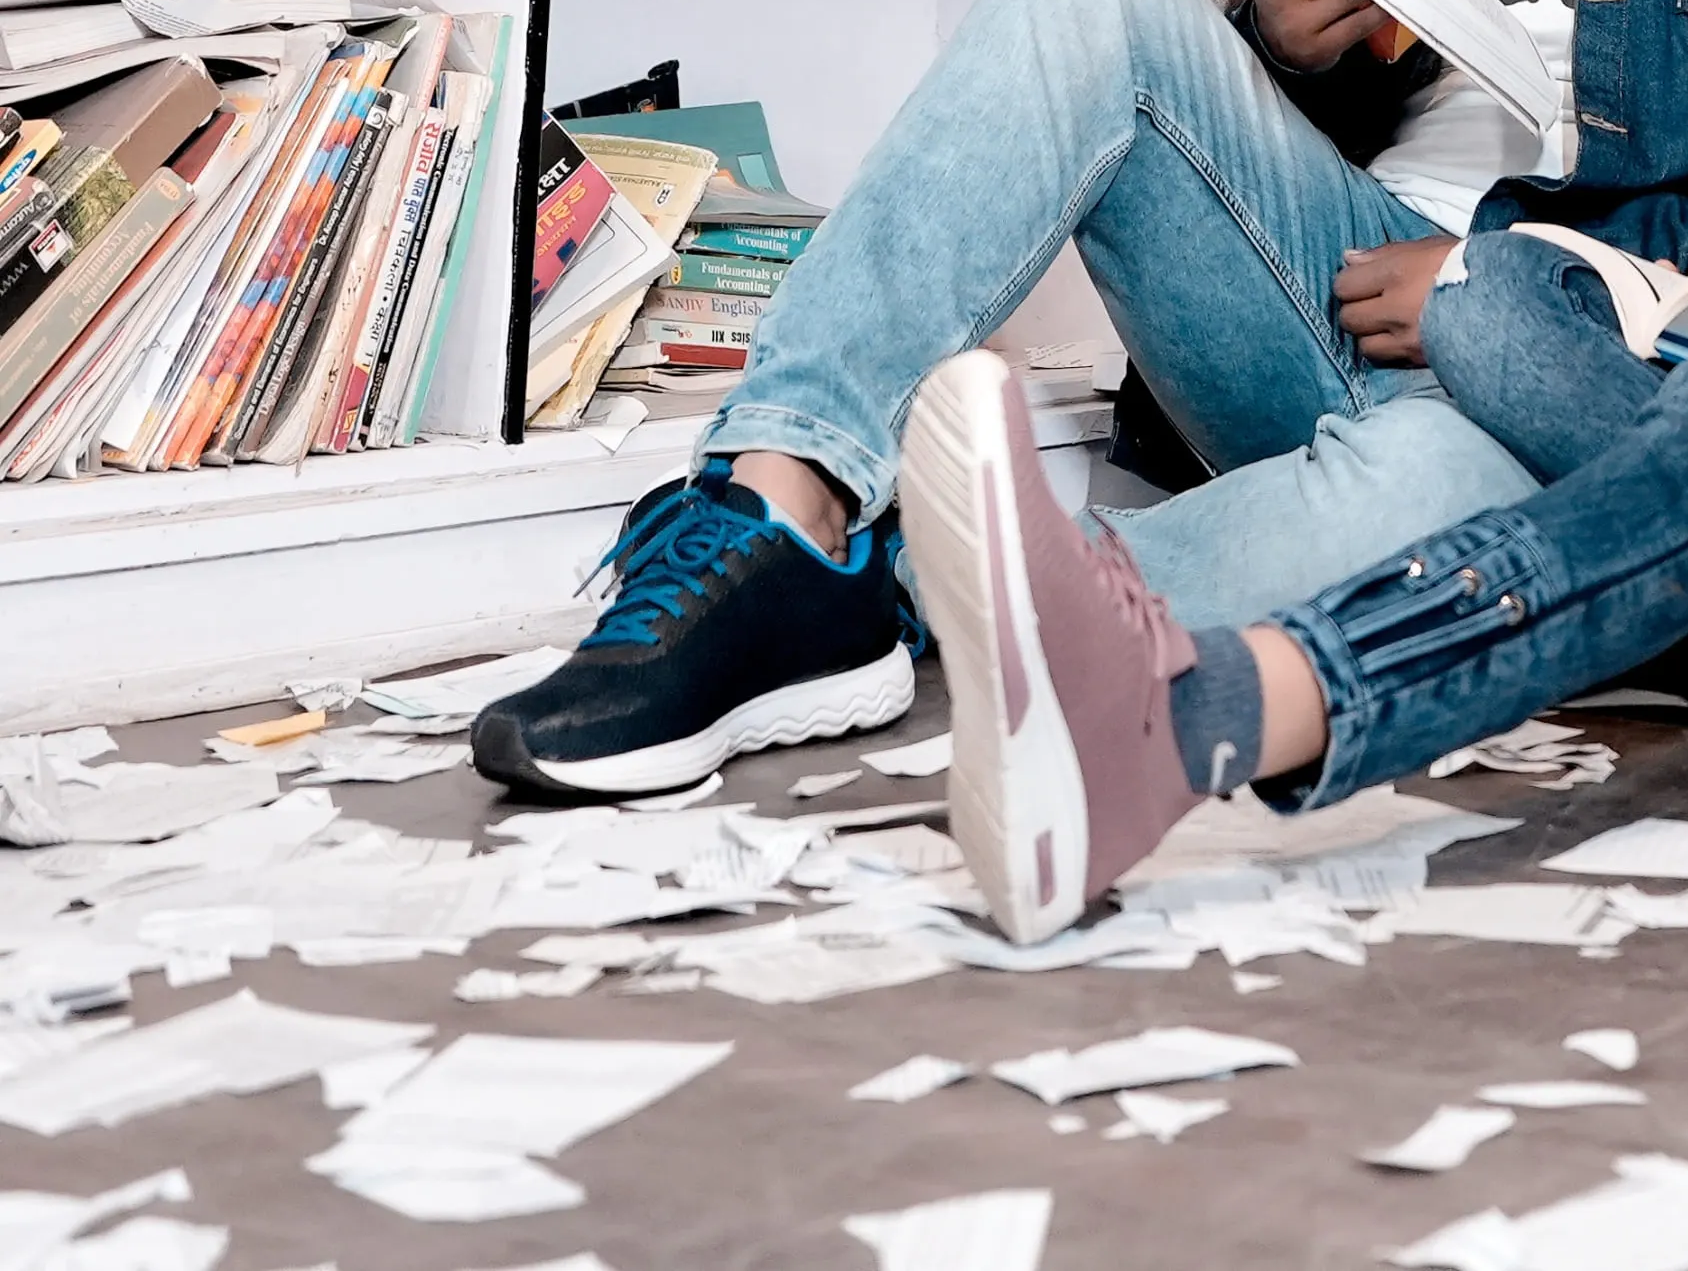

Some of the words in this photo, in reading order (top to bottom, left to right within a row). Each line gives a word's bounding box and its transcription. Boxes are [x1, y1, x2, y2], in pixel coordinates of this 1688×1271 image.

[357, 127, 374, 150] Goyal
[436, 128, 454, 169] Electronic
[351, 149, 365, 165] Ajay
[333, 185, 349, 208] Kumar
[413, 171, 441, 244] Communication
[317, 234, 328, 245] Dr.
[735, 234, 789, 252] Accounting
[791, 229, 802, 241] of
[66, 226, 131, 298] Accounting
[382, 229, 411, 293] चित्रकला
[410, 245, 419, 258] and
[78, 221, 156, 310] Fundamentals
[298, 257, 320, 293] Engineers
[403, 259, 415, 281] Data
[701, 262, 770, 279] Fundamentals
[772, 268, 784, 280] of
[715, 276, 770, 294] Accounting
[291, 292, 303, 306] for
[655, 292, 704, 312] SANJIV
[711, 297, 762, 317] English
[66, 305, 86, 325] of
[275, 305, 298, 345] Economics
[367, 306, 388, 342] कक्षा
[383, 281, 408, 353] Communication
[710, 330, 724, 343] XII
[730, 332, 750, 345] sics
[271, 344, 282, 354] of
[360, 351, 375, 369] 11
[256, 353, 277, 388] Elements
[259, 381, 281, 415] Digital
[272, 354, 293, 382] Logic
[284, 317, 308, 355] Design
[250, 388, 262, 404] and
